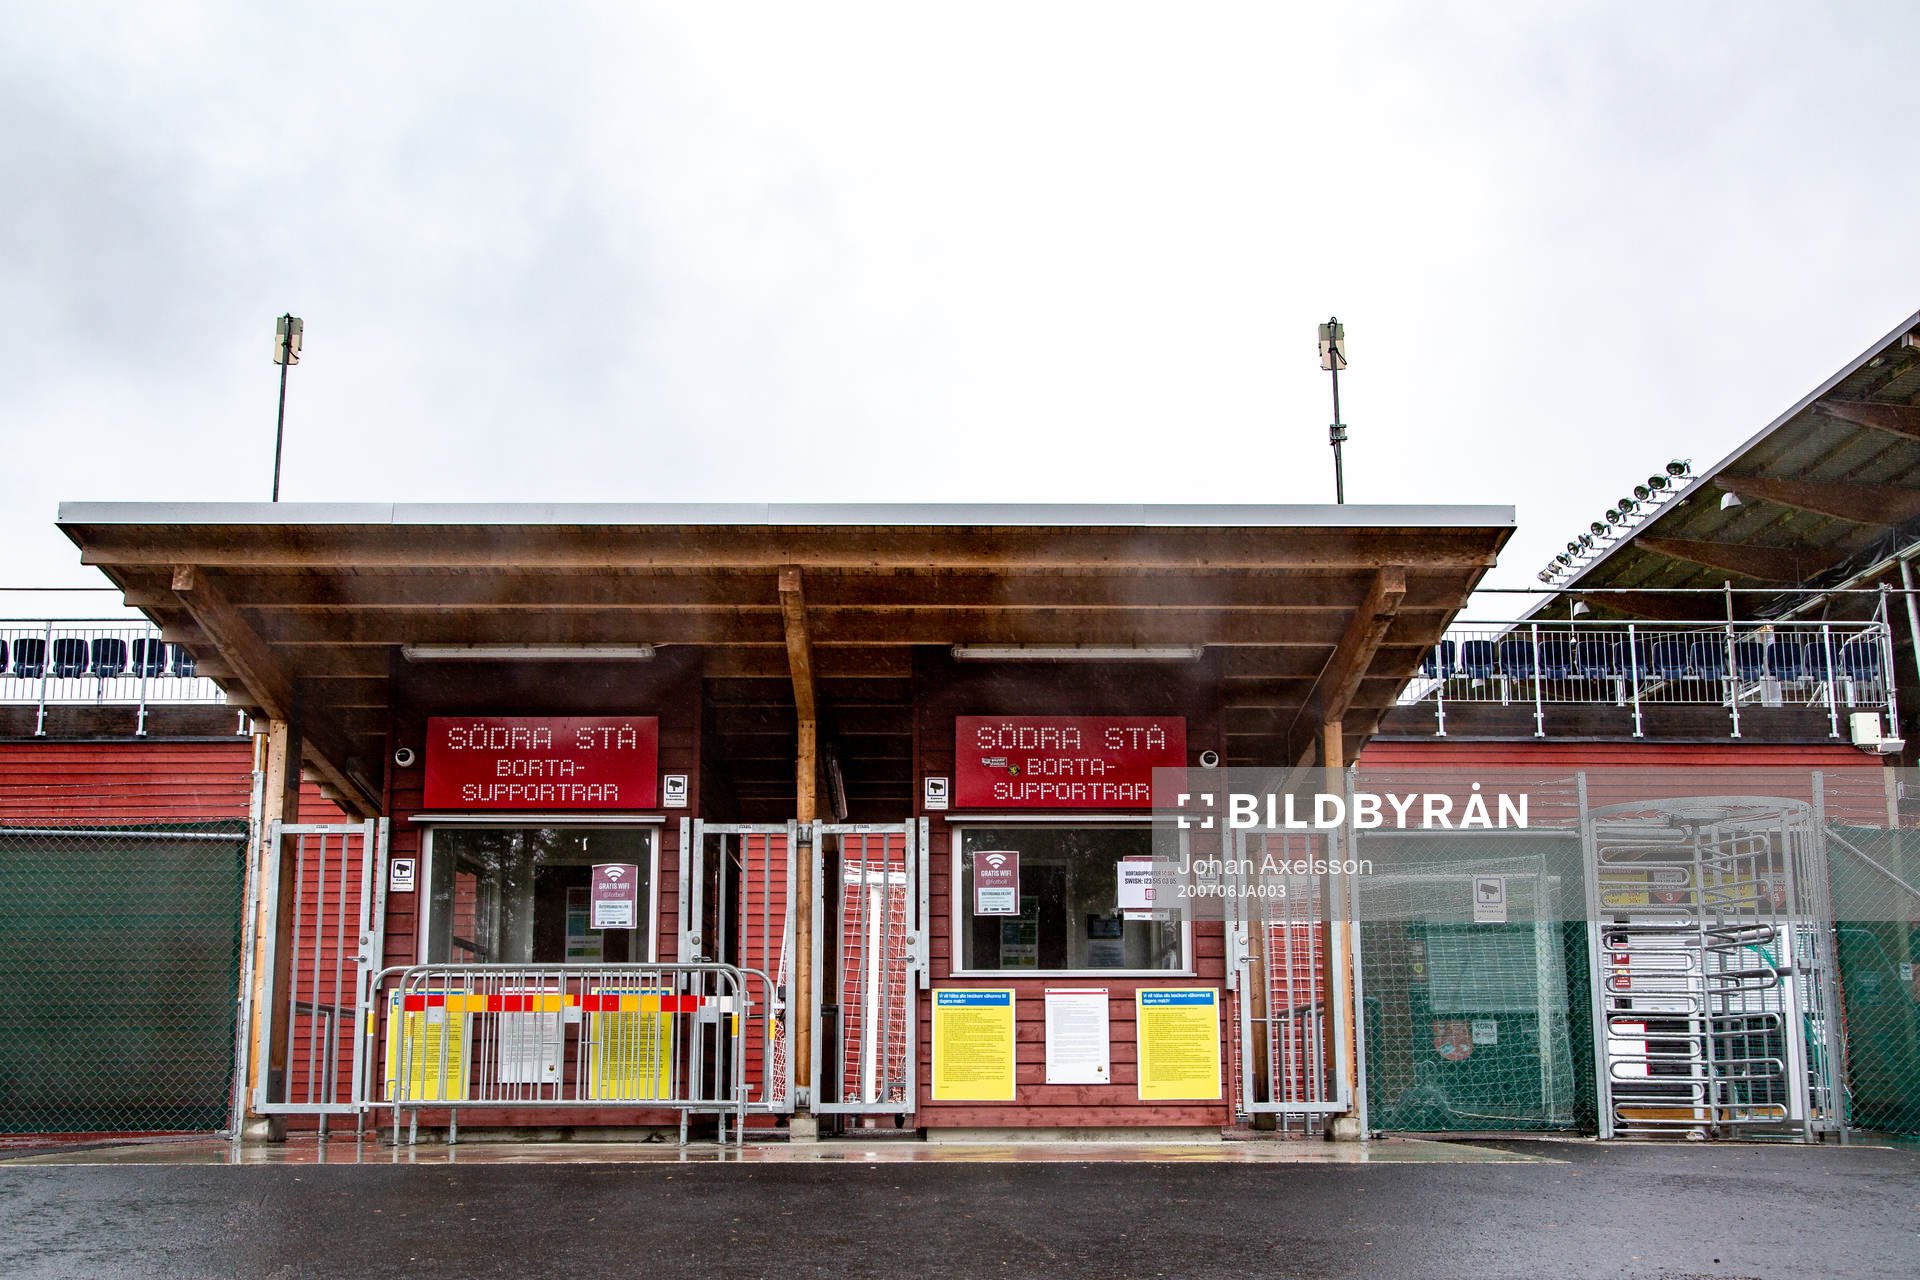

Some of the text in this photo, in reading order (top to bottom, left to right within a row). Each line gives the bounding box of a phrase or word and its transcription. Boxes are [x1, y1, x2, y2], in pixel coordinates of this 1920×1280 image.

[448, 723, 637, 750] SÖDRA STÅ
[977, 723, 1165, 750] SÖDRA STÅ
[497, 759, 585, 777] BORTA-
[1027, 758, 1115, 776] BORTA-
[462, 784, 618, 801] SUPPORTRAR
[993, 782, 1150, 801] SUPPORTRAR
[599, 882, 630, 890] GRATIS WIFI
[1665, 892, 1674, 902] 3
